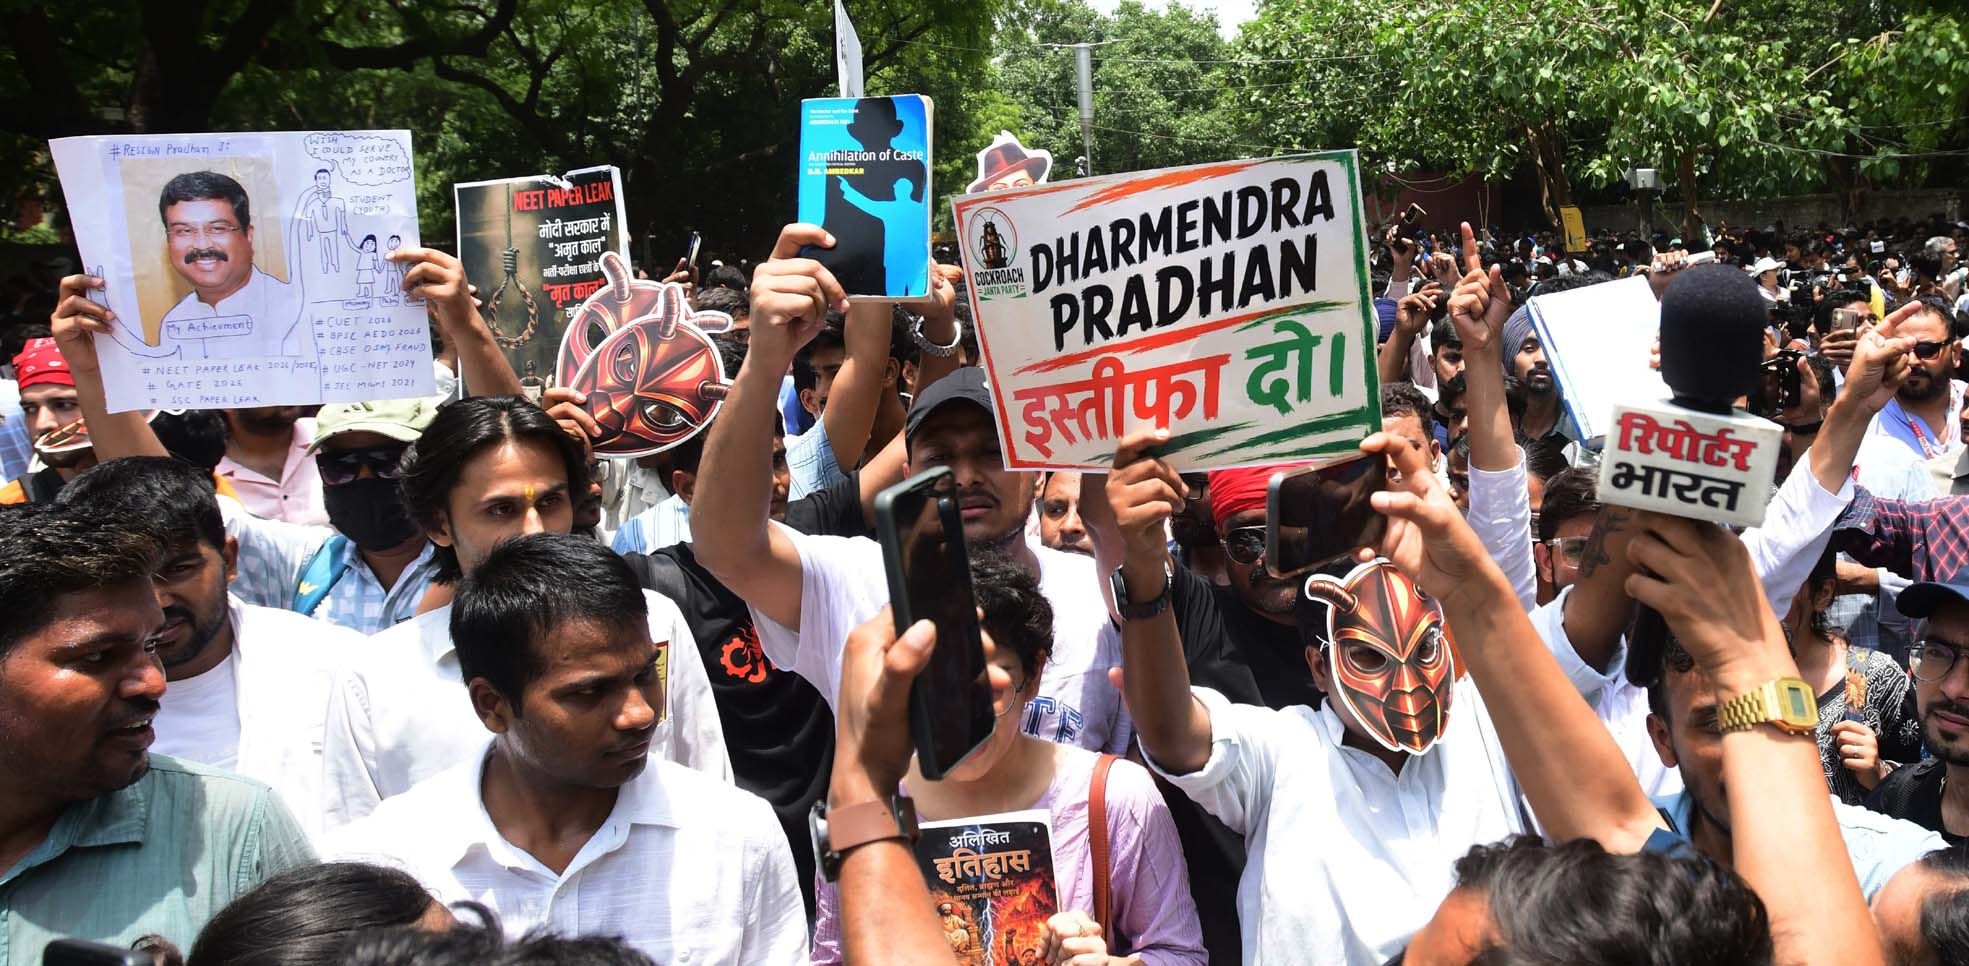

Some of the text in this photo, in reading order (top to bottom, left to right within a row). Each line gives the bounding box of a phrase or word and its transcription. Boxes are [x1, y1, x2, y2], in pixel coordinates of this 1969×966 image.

[309, 136, 338, 145] WISH
[322, 146, 353, 154] COULD
[360, 144, 391, 153] SERVE
[809, 148, 924, 161] Annihilation of Caste
[349, 194, 392, 203] STUDENT
[513, 181, 613, 212] NEET PAPER LEAK
[538, 212, 610, 239] मोदी सरकार में
[1030, 169, 1335, 294] DHARMENDRA
[974, 267, 1025, 286] COCKROACH
[984, 284, 1019, 296] JANTA PARTY
[1050, 234, 1318, 352] PRADHAN
[327, 316, 361, 327] CUET
[395, 343, 426, 352] FRAUD
[156, 366, 190, 375] NEET
[195, 365, 229, 374] PAPER
[334, 362, 357, 373] UGC
[166, 379, 202, 390] GATE
[200, 394, 228, 404] PAPER
[1013, 354, 1231, 459] इस्तीफा
[1617, 411, 1758, 472] रिपोर्टर
[1611, 461, 1746, 512] भारत
[949, 828, 1010, 848] अलिखित
[933, 847, 1031, 884] इतिहास
